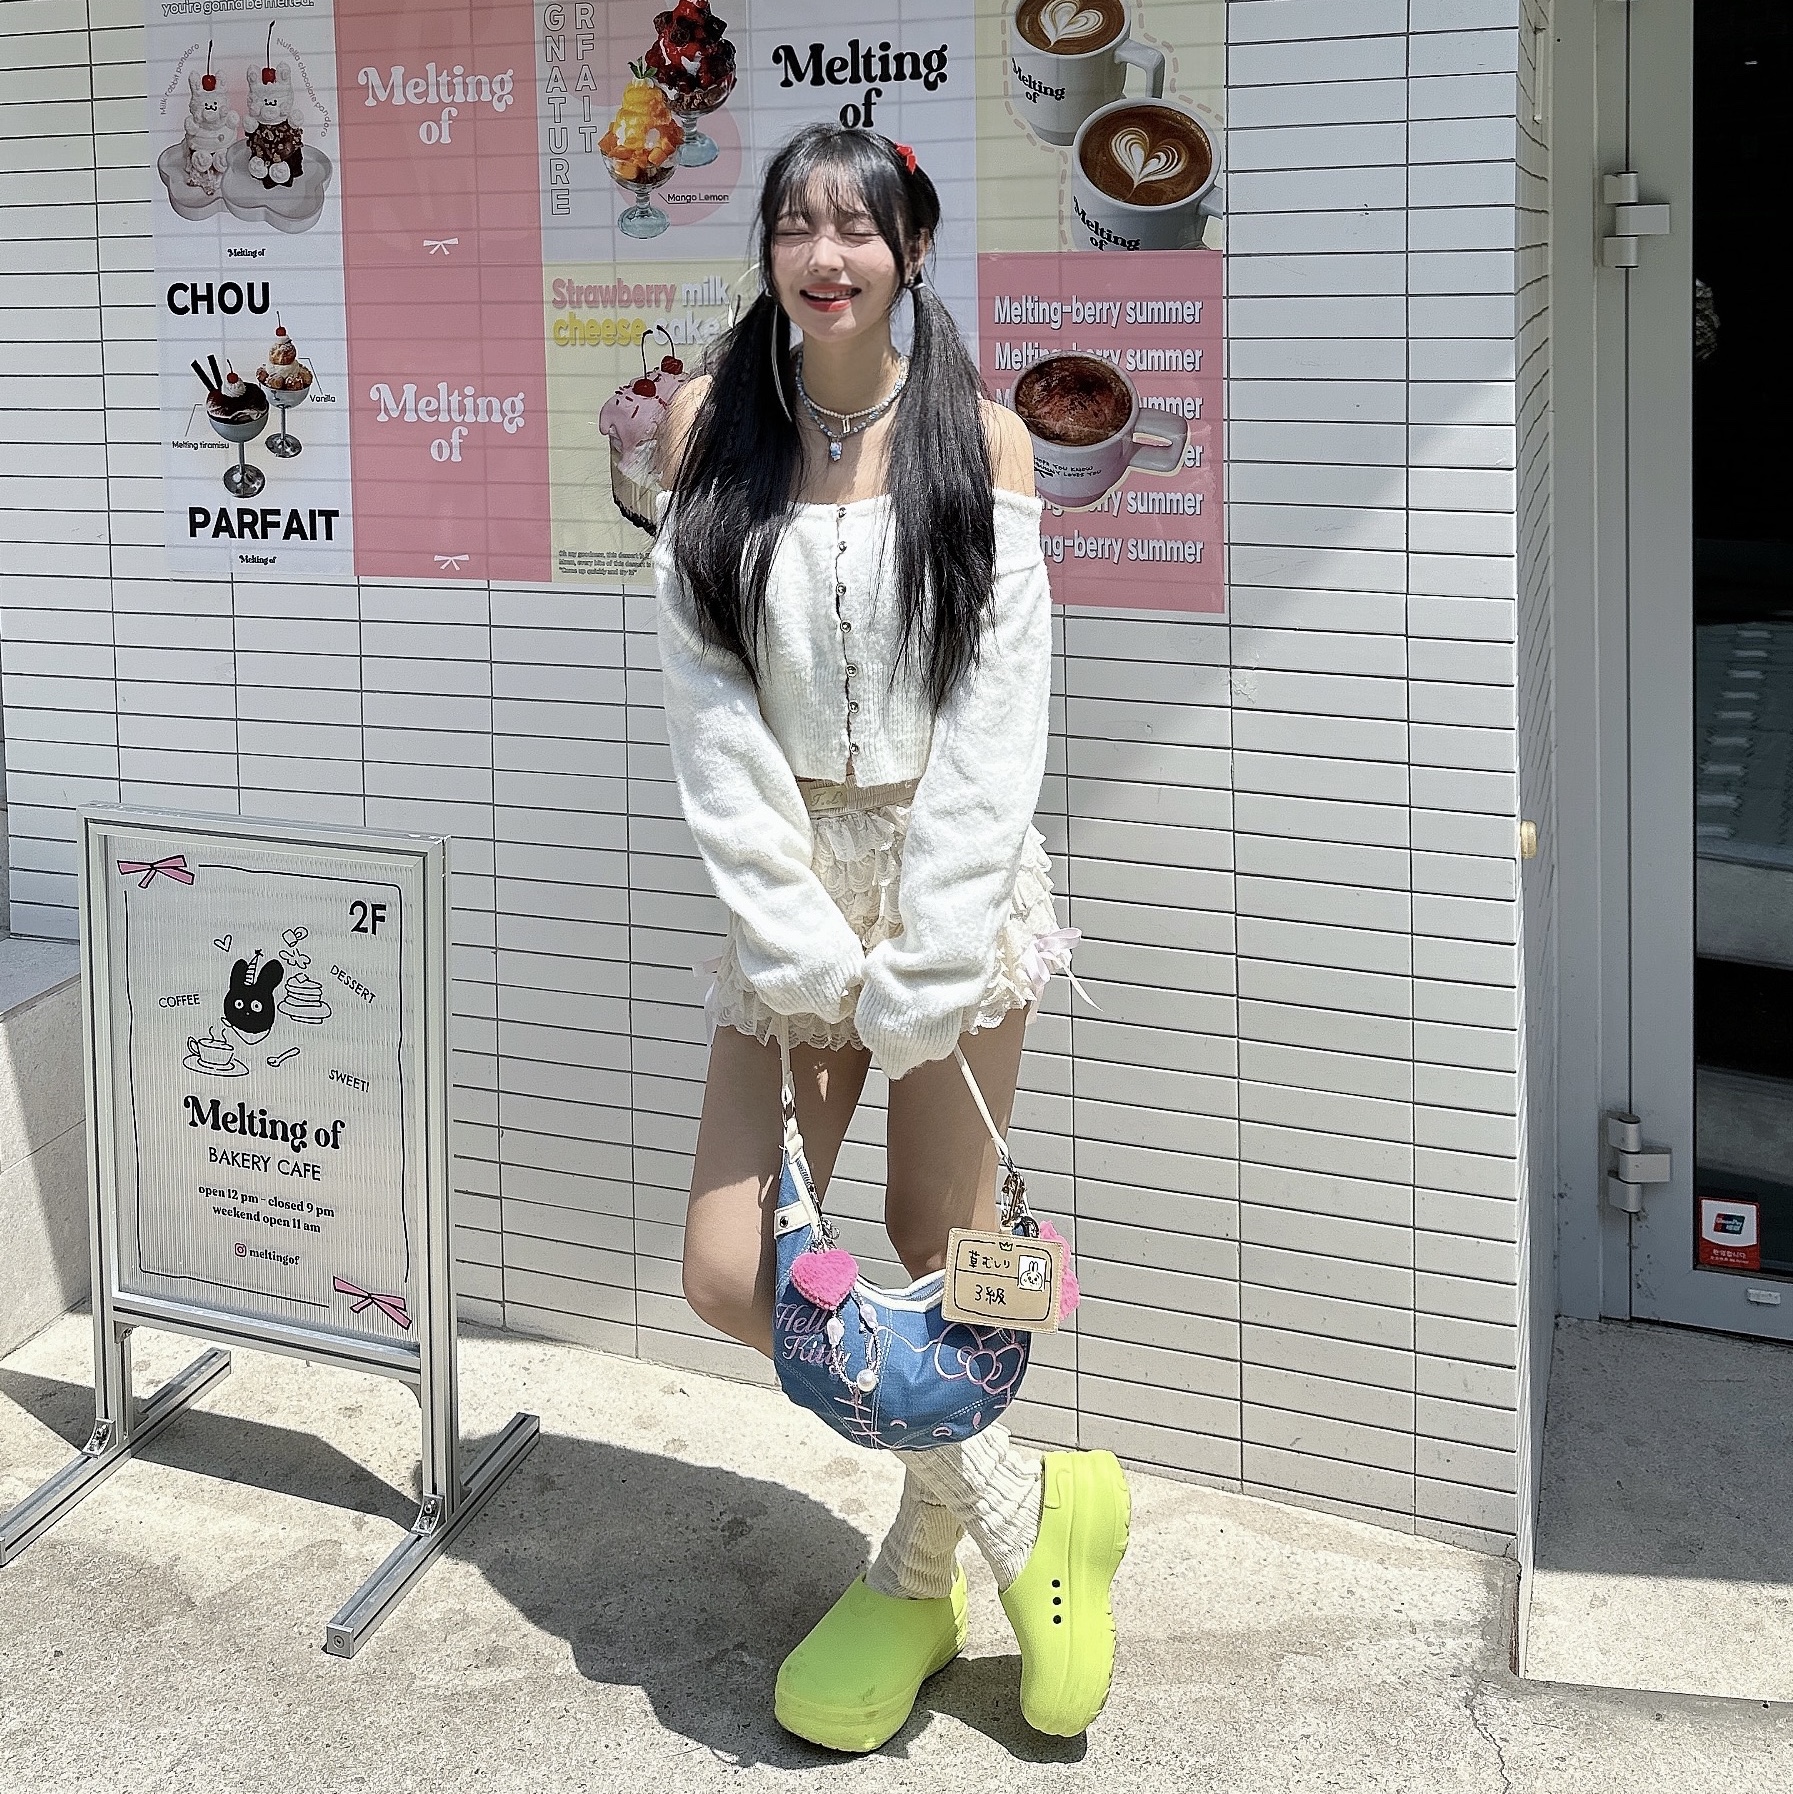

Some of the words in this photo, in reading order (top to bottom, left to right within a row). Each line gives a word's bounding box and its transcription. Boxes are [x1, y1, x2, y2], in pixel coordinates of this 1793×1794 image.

[203, 0, 245, 15] gonna
[176, 43, 200, 74] pandoro
[771, 38, 948, 91] Melting
[276, 37, 301, 61] Nutella
[298, 61, 317, 102] chocolate
[313, 102, 332, 137] pandoro
[357, 62, 514, 112] Melting
[1012, 57, 1066, 101] Melting
[839, 87, 883, 129] of
[1025, 91, 1041, 103] of
[418, 107, 458, 145] of
[667, 193, 697, 203] Mango
[698, 193, 729, 201] Lemon
[1073, 196, 1141, 251] Melting
[227, 247, 257, 258] Melting
[257, 248, 266, 257] of
[1089, 236, 1108, 251] of
[167, 281, 270, 315] CHOU
[551, 277, 678, 312] Strawberry
[681, 275, 730, 307] milk
[553, 311, 648, 346] cheese
[652, 311, 722, 345] cake
[994, 295, 1122, 330] Melting-berry
[1125, 299, 1203, 324] summer
[1125, 348, 1203, 372] summer
[369, 382, 526, 434] Melting
[172, 440, 199, 451] Melting
[199, 440, 230, 449] tiramisu
[430, 425, 469, 462] of
[1126, 490, 1204, 516] summer
[188, 506, 340, 541] PARFAIT
[238, 555, 269, 566] Melting
[269, 556, 278, 564] of
[1127, 538, 1204, 564] summer
[349, 900, 387, 935] 2F
[330, 964, 376, 1005] DESSERT
[158, 993, 201, 1009] COFFEE
[328, 1069, 370, 1093] SWEET!
[183, 1095, 308, 1153] Melting
[314, 1119, 346, 1150] of
[208, 1146, 272, 1173] BAKERY
[277, 1159, 321, 1182] CAFE
[198, 1186, 226, 1198] open
[227, 1188, 239, 1201] 12
[240, 1193, 259, 1205] pm
[268, 1196, 304, 1213] closed
[306, 1202, 314, 1213] 9
[315, 1206, 335, 1218] pm
[212, 1205, 261, 1222] weekend
[262, 1215, 290, 1228] open
[292, 1218, 302, 1230] 11
[303, 1222, 321, 1234] am
[249, 1248, 300, 1266] meltingof
[968, 1249, 1011, 1269] 草むしり
[974, 1284, 1007, 1305] 3級
[775, 1302, 829, 1334] Hell
